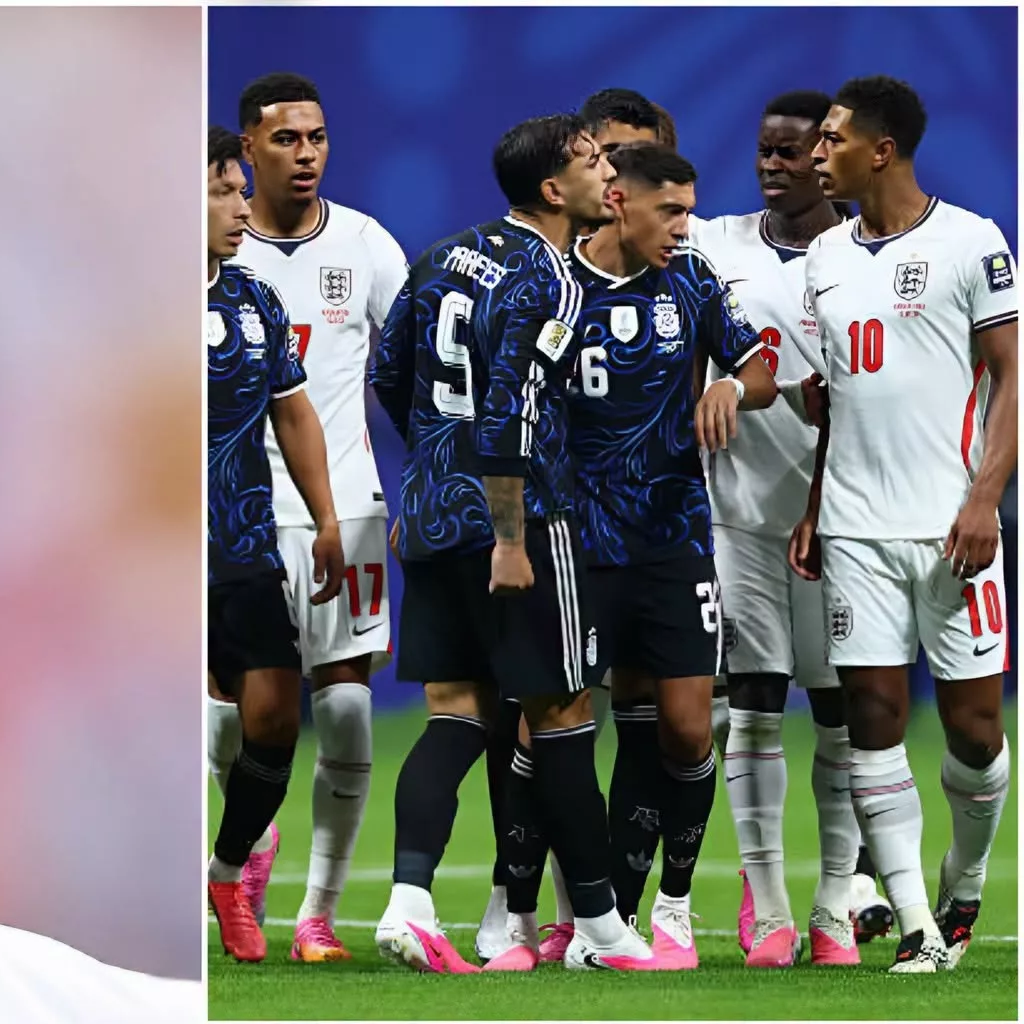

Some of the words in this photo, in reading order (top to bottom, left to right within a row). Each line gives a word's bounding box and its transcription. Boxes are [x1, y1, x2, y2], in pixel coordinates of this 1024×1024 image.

[431, 290, 476, 420] 5
[847, 318, 884, 375] 10
[344, 562, 384, 618] 17
[960, 579, 1003, 638] 10
